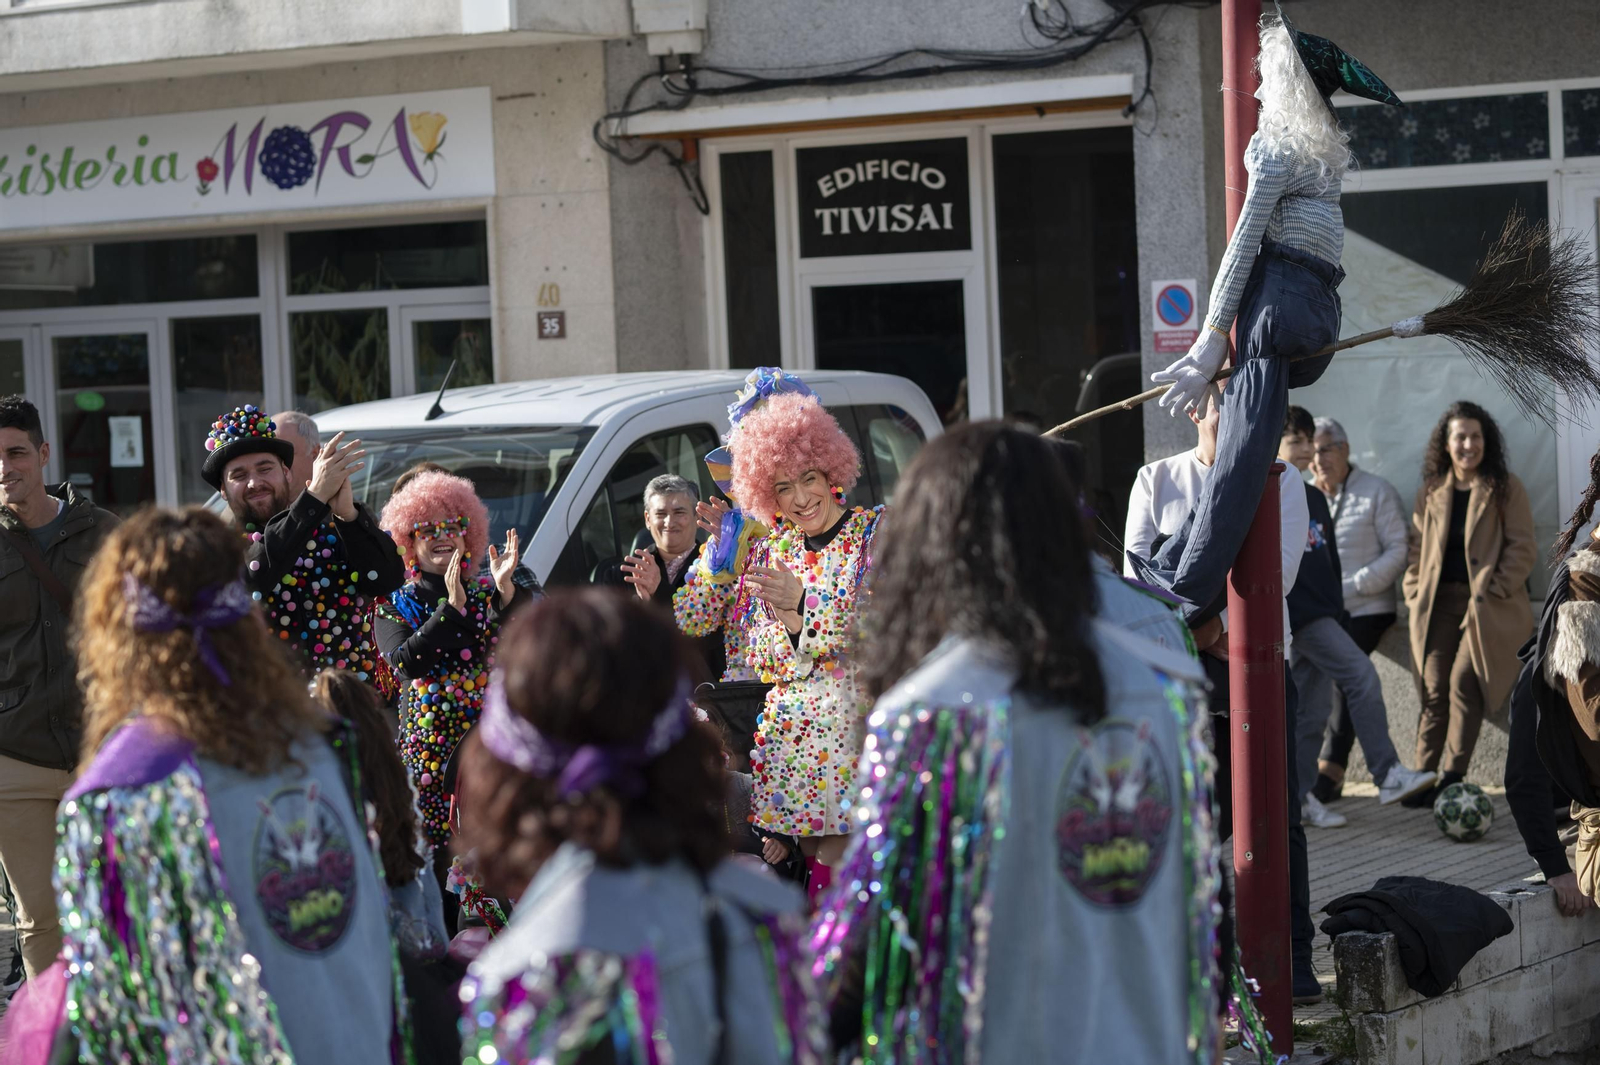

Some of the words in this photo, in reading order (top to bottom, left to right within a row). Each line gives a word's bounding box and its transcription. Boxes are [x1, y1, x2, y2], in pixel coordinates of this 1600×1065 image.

[817, 159, 946, 198] EDIFICIO
[814, 202, 953, 235] TIVISAI
[542, 318, 559, 335] 35
